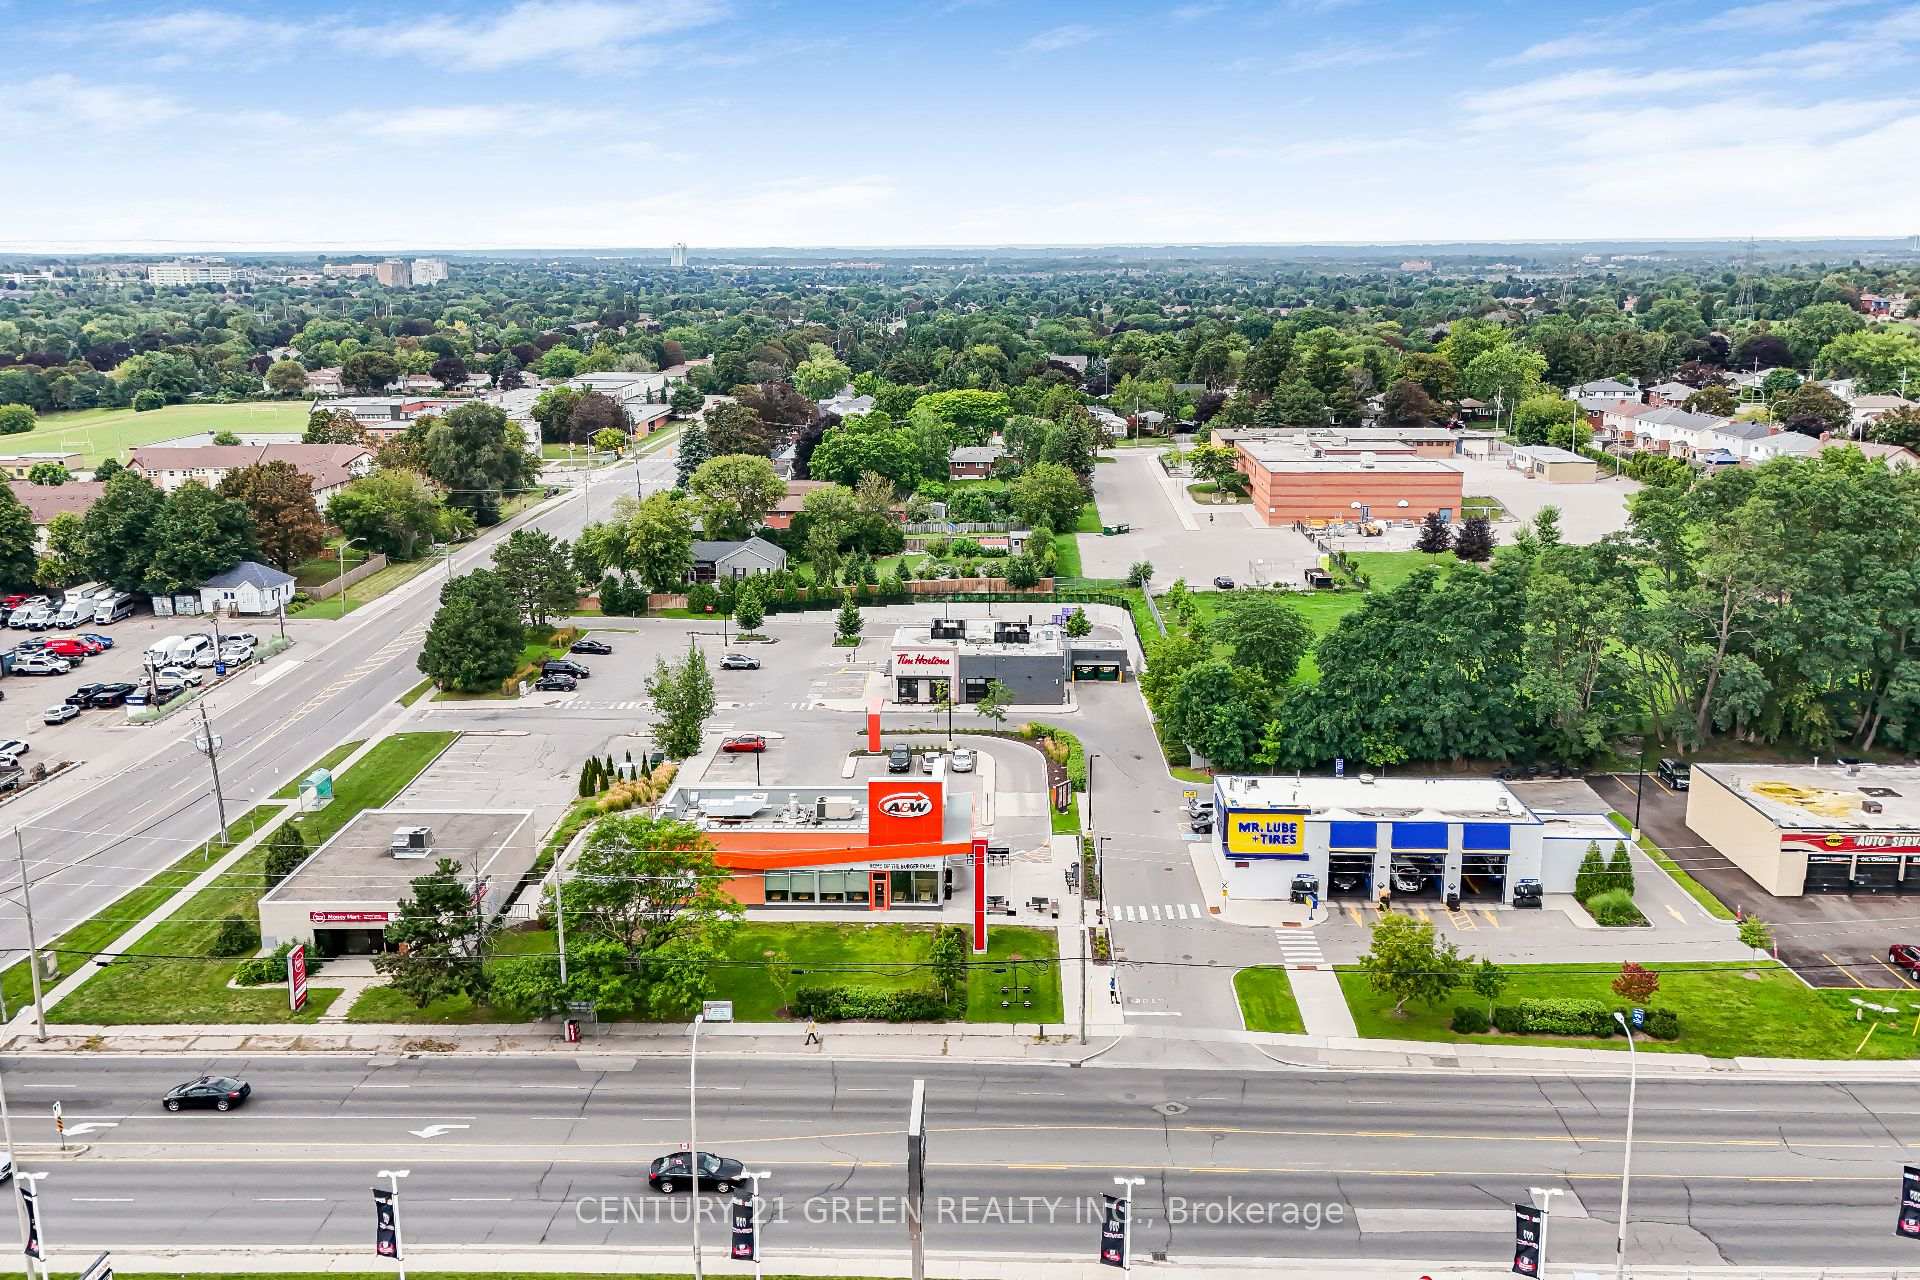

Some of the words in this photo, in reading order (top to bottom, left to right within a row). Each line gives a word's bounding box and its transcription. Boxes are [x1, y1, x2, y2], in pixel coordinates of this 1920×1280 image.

[896, 653, 913, 665] Tim
[914, 653, 950, 665] Hortons
[886, 802, 929, 813] A&W
[1238, 822, 1264, 833] MR.
[1266, 822, 1298, 833] LUBE
[1856, 835, 1887, 847] AUTO
